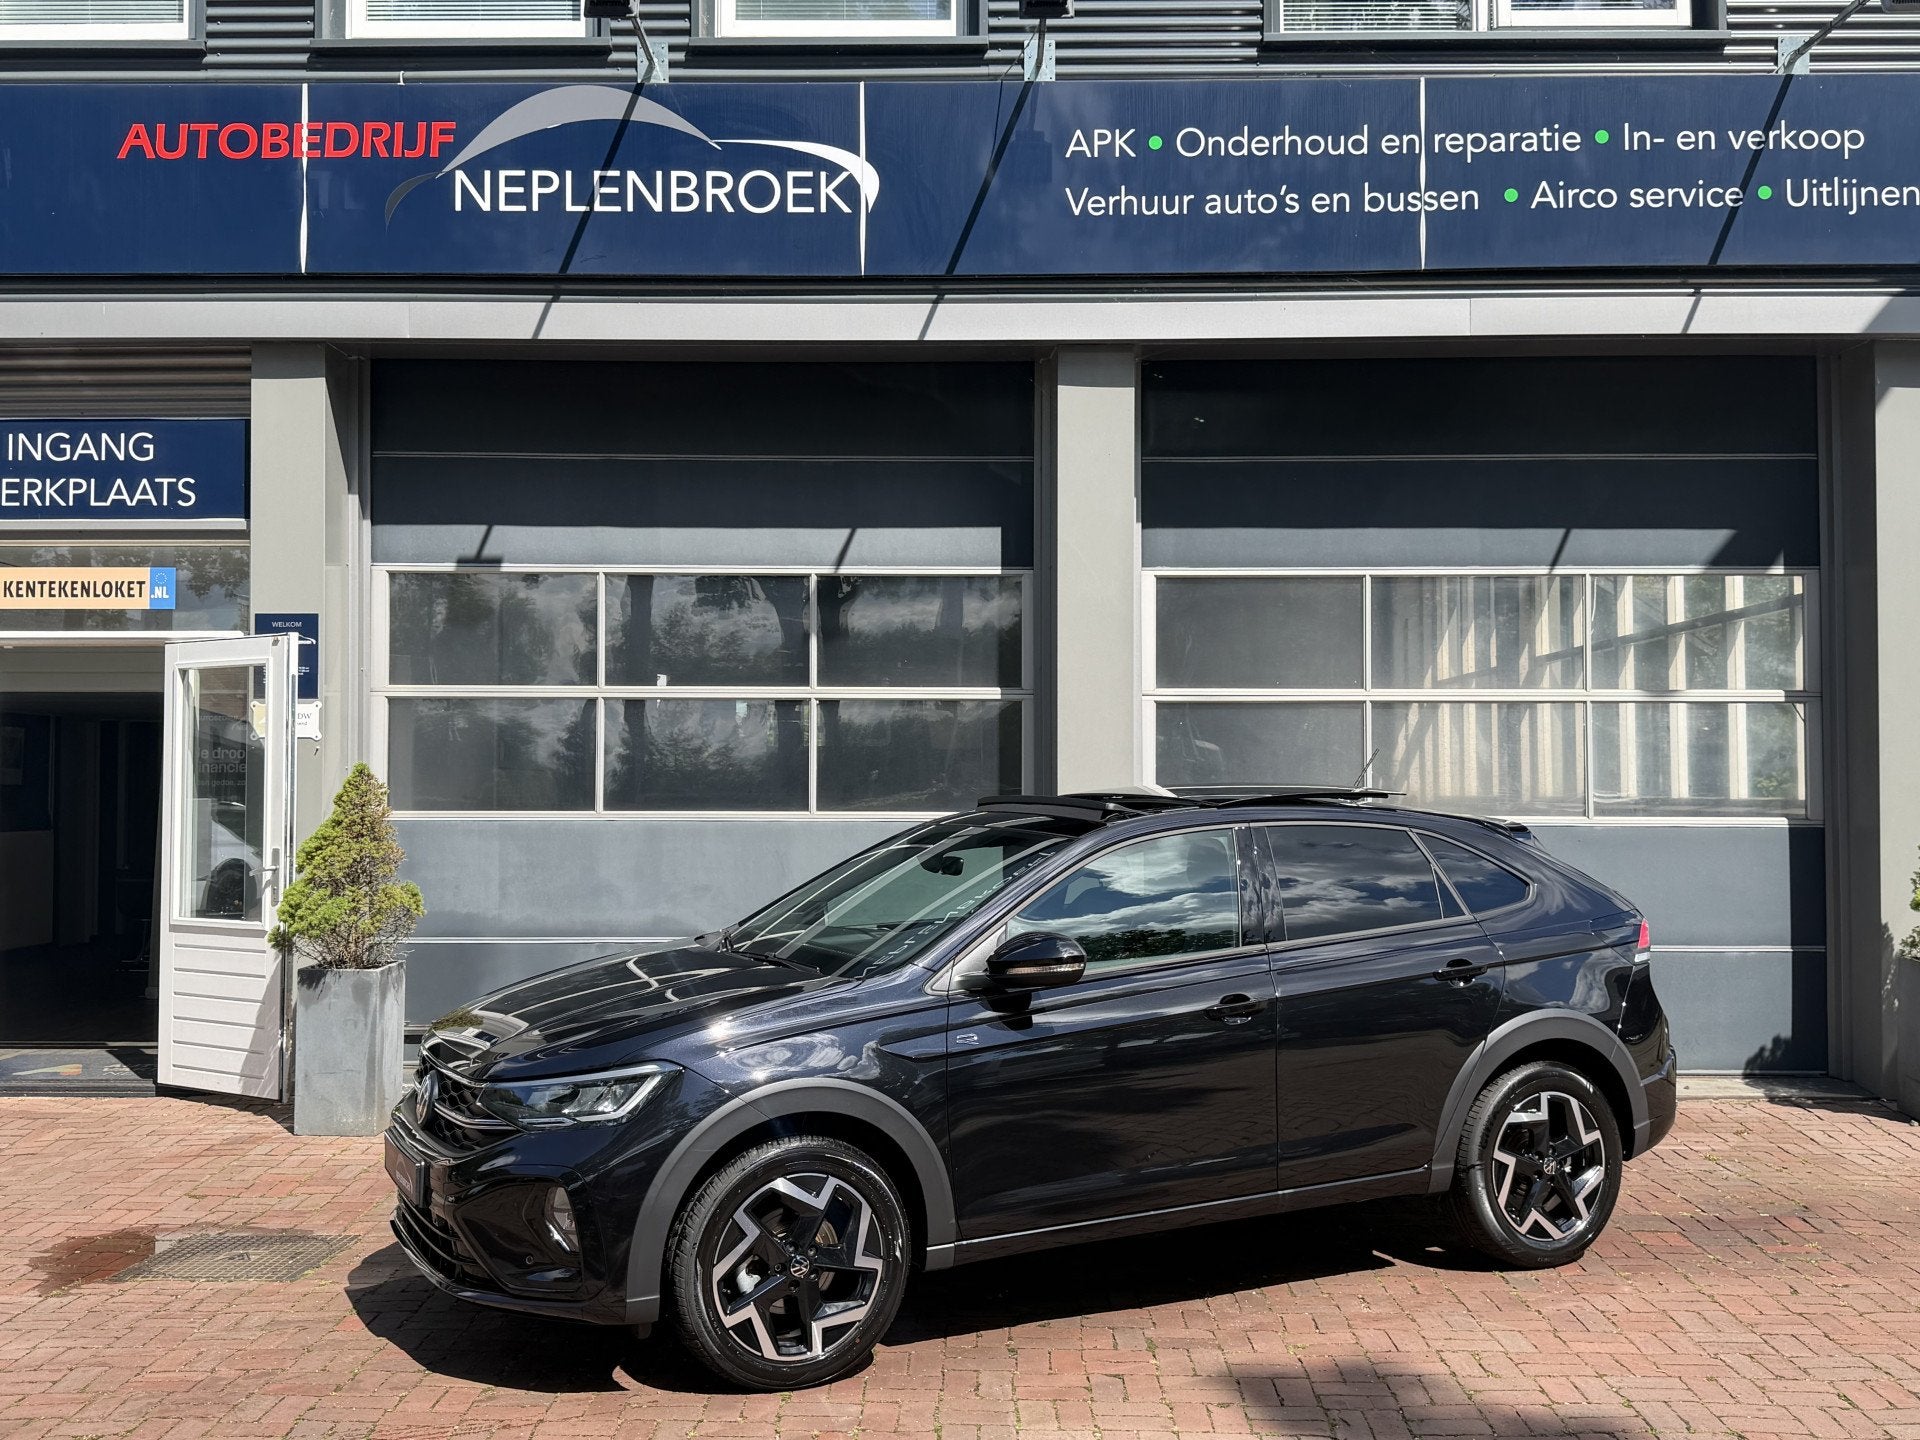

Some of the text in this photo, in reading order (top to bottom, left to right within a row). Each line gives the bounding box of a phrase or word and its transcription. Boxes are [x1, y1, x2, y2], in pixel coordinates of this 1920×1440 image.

[116, 121, 457, 160] AUTOBEDRIJF
[1065, 119, 1865, 163] APK Onderhoud en reparatie In- en verkoop
[453, 169, 853, 214] NEPLENBROEK
[1064, 176, 1920, 216] Verhuur auto's en bussen Airco service Uitlijnen
[8, 432, 154, 462] INGANG
[1, 477, 196, 507] ERKPLAATS
[3, 580, 146, 598] KENTEKENLOKET
[297, 712, 312, 720] DW
